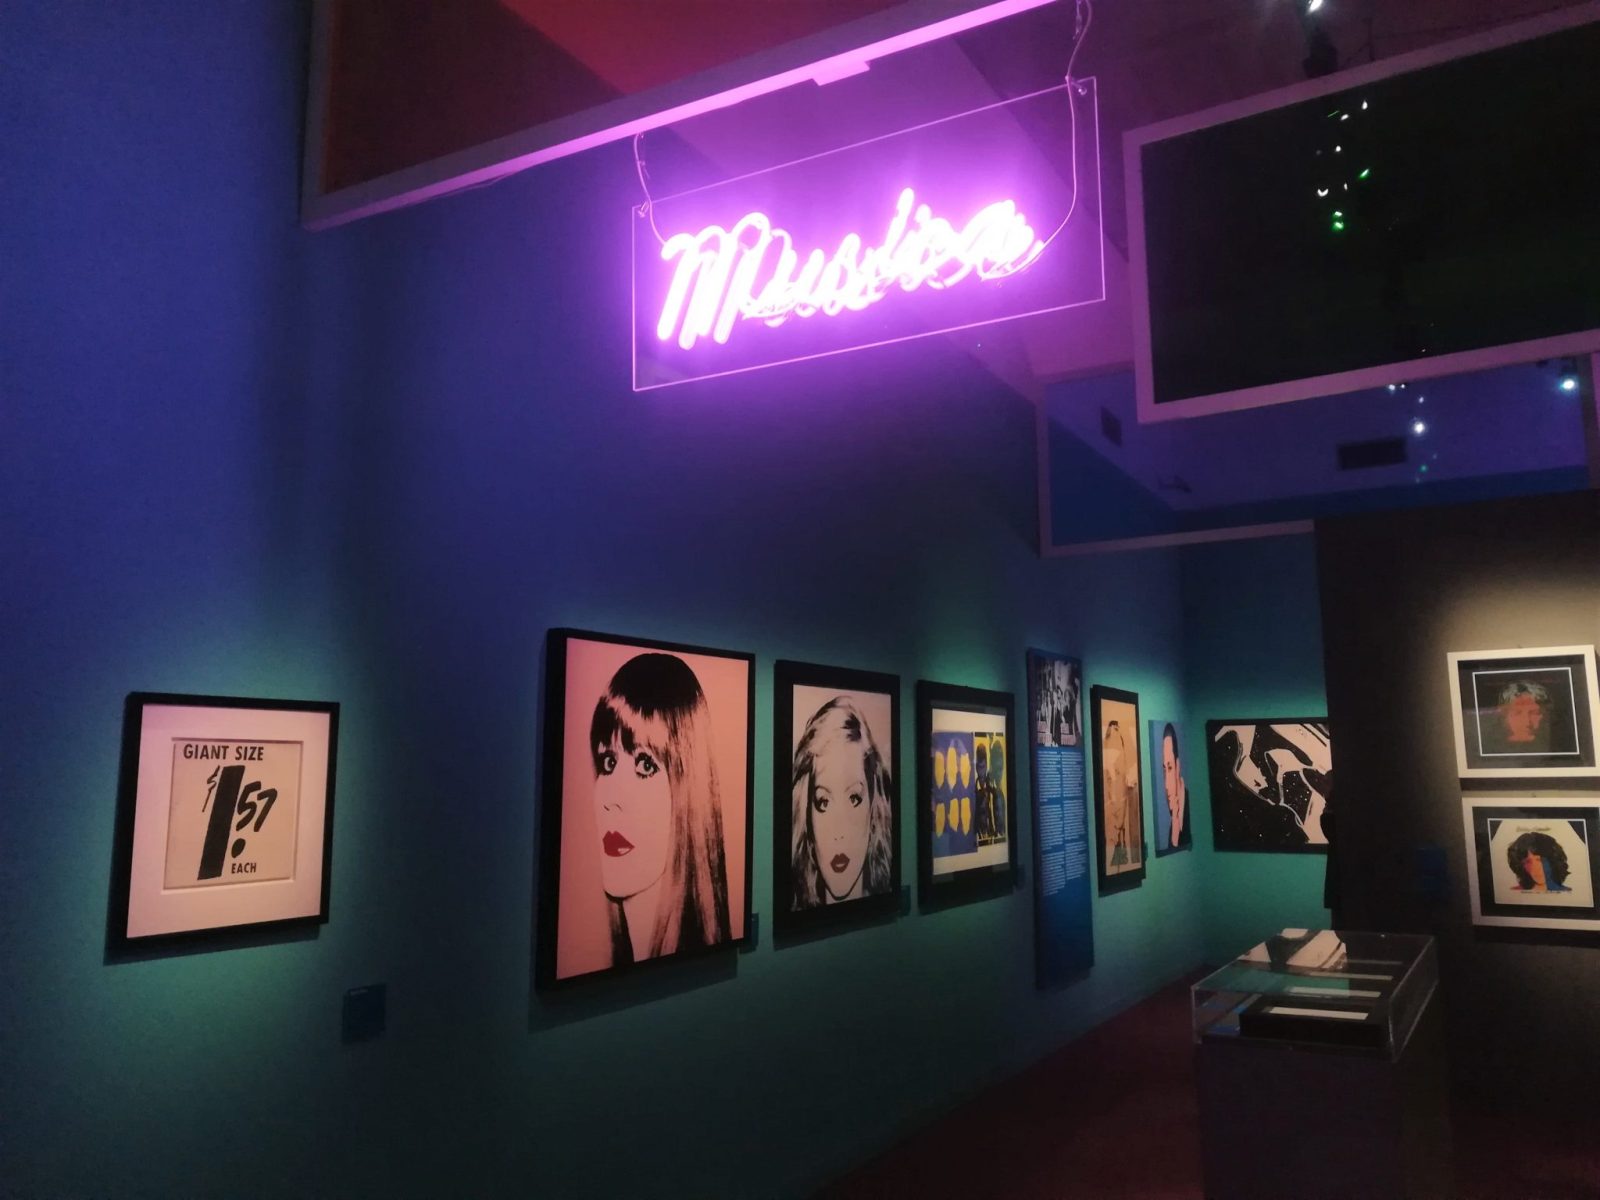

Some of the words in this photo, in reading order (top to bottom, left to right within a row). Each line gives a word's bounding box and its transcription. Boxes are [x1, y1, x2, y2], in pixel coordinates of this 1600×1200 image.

[183, 743, 229, 761] GIANT
[235, 746, 264, 761] SIZE
[231, 862, 257, 874] EACH
